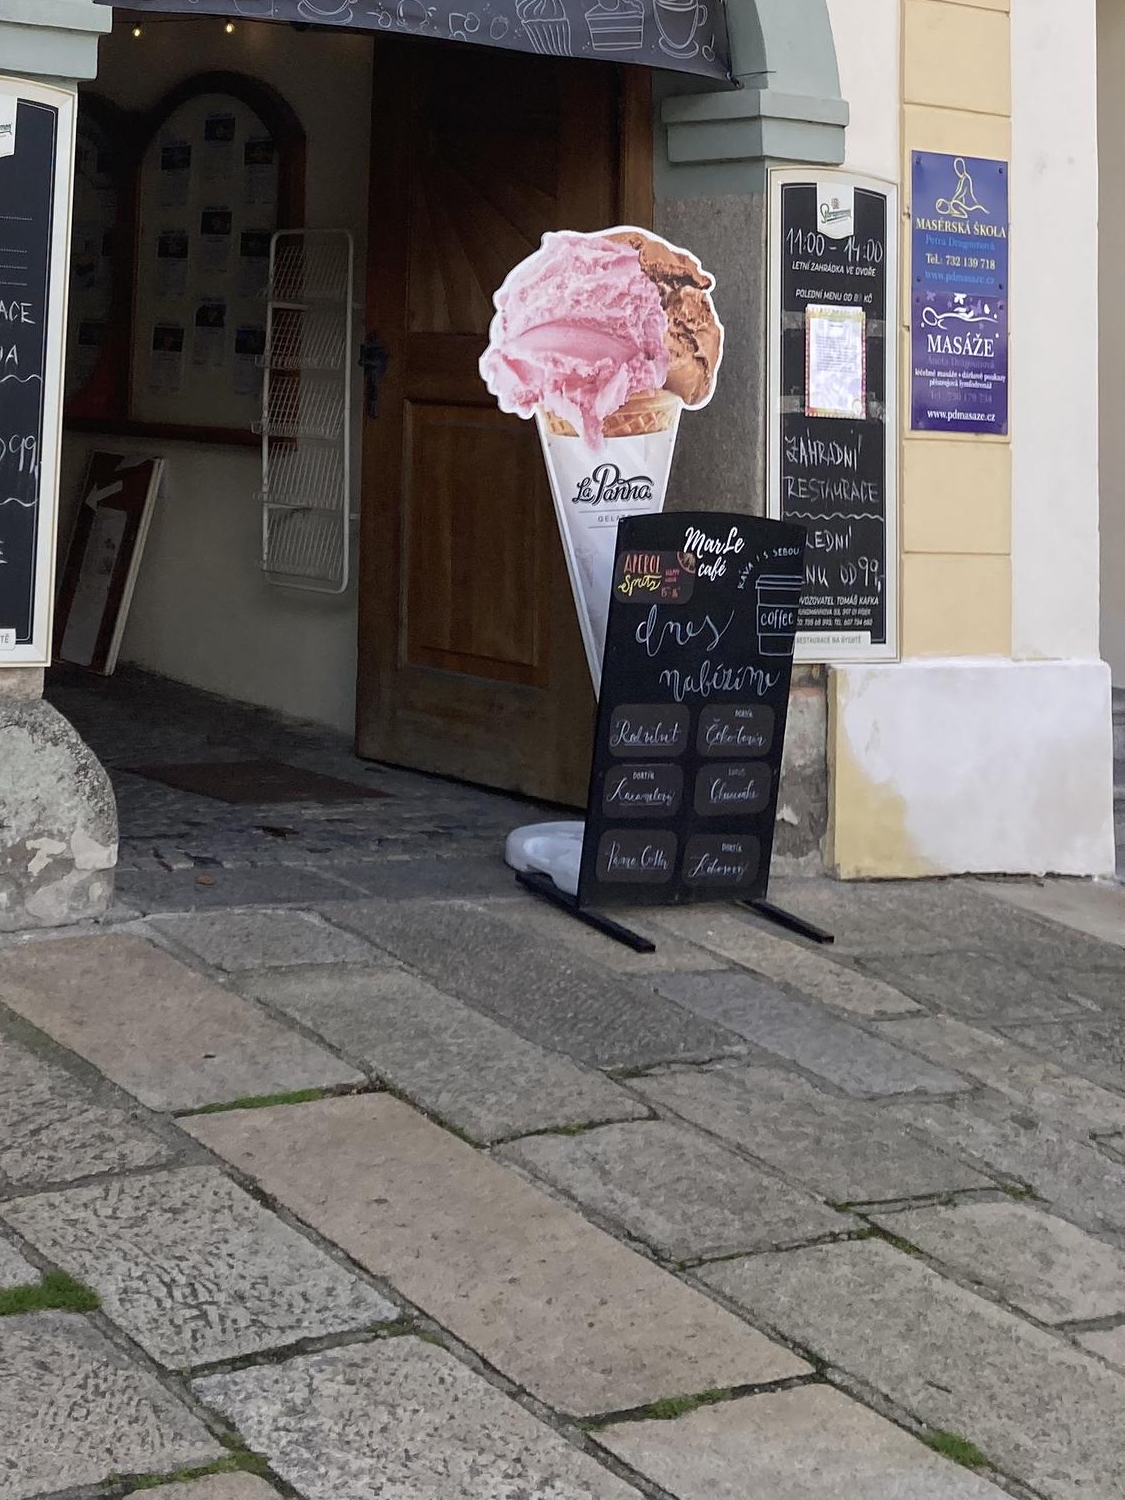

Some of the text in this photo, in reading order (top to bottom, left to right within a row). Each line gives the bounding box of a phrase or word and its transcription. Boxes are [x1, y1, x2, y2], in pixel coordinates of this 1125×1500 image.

[916, 217, 1006, 238] MASÉRSKÁ ŠKOLA
[786, 227, 825, 256] 11:00
[843, 236, 883, 263] 14:00
[792, 261, 811, 270] LETNÍ
[811, 263, 844, 274] ZAHRÁDKA
[846, 266, 854, 275] VE
[945, 256, 961, 267] 732
[964, 257, 978, 268] 139
[980, 259, 995, 270] 718
[796, 289, 823, 299] POLEDNÍ
[824, 291, 842, 301] MENU
[843, 293, 852, 301] OD
[927, 332, 994, 358] MASÁŽE
[927, 409, 996, 422] www.pdmasaze.cz
[572, 463, 654, 506] La Panna
[784, 476, 879, 503] RESTAURACE
[683, 526, 745, 559] MarLe
[805, 525, 853, 552] LEDNÍ
[772, 548, 800, 557] SEBOU
[624, 554, 660, 574] APEROL
[697, 556, 727, 582] café
[859, 596, 879, 605] KAFKA
[761, 610, 794, 629] coffee
[635, 604, 735, 658] dnes
